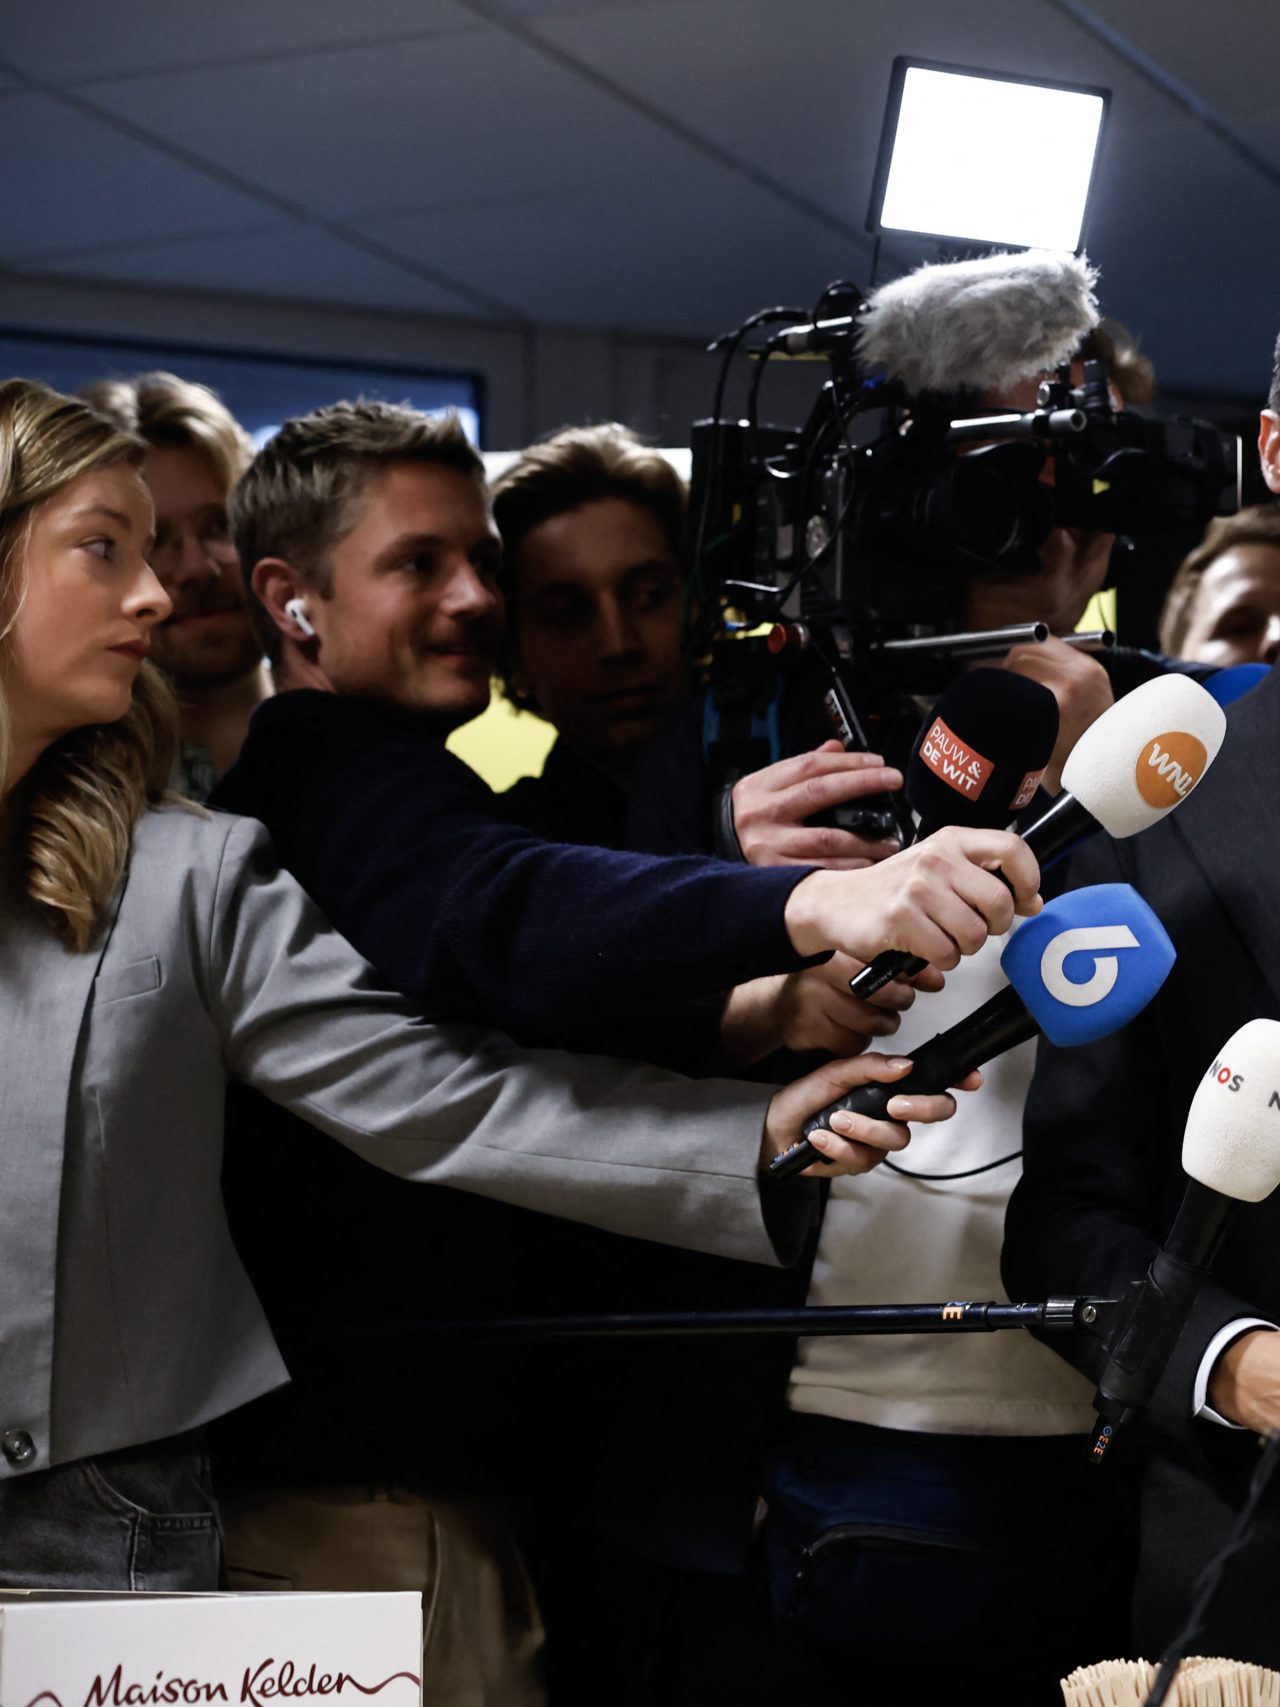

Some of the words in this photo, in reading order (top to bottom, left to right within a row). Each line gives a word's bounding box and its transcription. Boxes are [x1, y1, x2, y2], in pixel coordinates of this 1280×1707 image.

[923, 740, 941, 766] DE
[943, 758, 977, 791] WIT
[930, 725, 970, 766] PAUW
[967, 761, 981, 779] &
[1209, 1060, 1244, 1092] NOS
[83, 1664, 228, 1707] Maison
